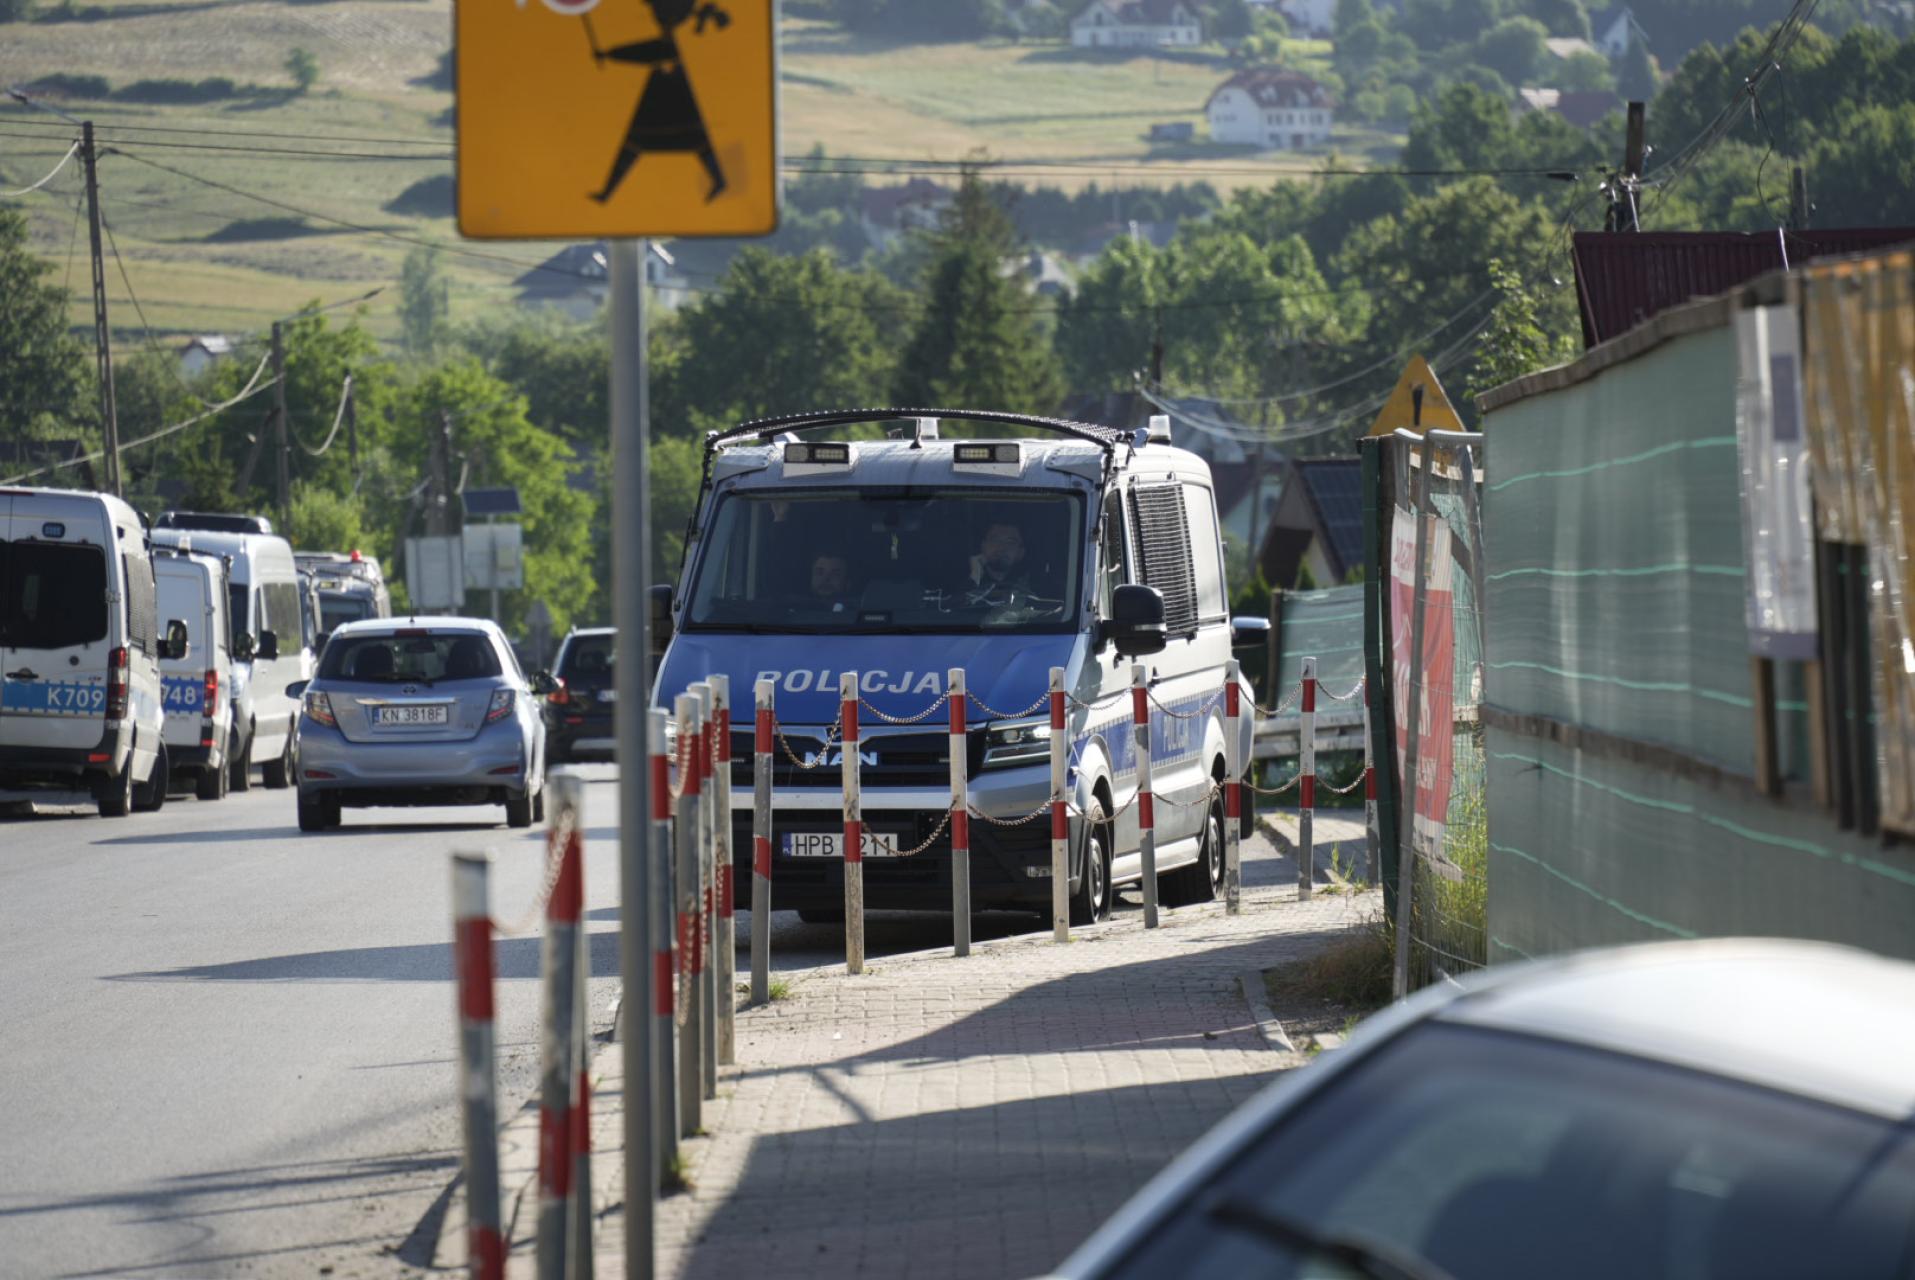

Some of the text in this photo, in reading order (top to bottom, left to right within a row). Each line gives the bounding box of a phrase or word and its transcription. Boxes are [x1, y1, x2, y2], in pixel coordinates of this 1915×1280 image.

[753, 669, 941, 694] POLCJA
[48, 688, 104, 708] K709
[382, 708, 399, 721] KN
[795, 835, 834, 856] HPB
